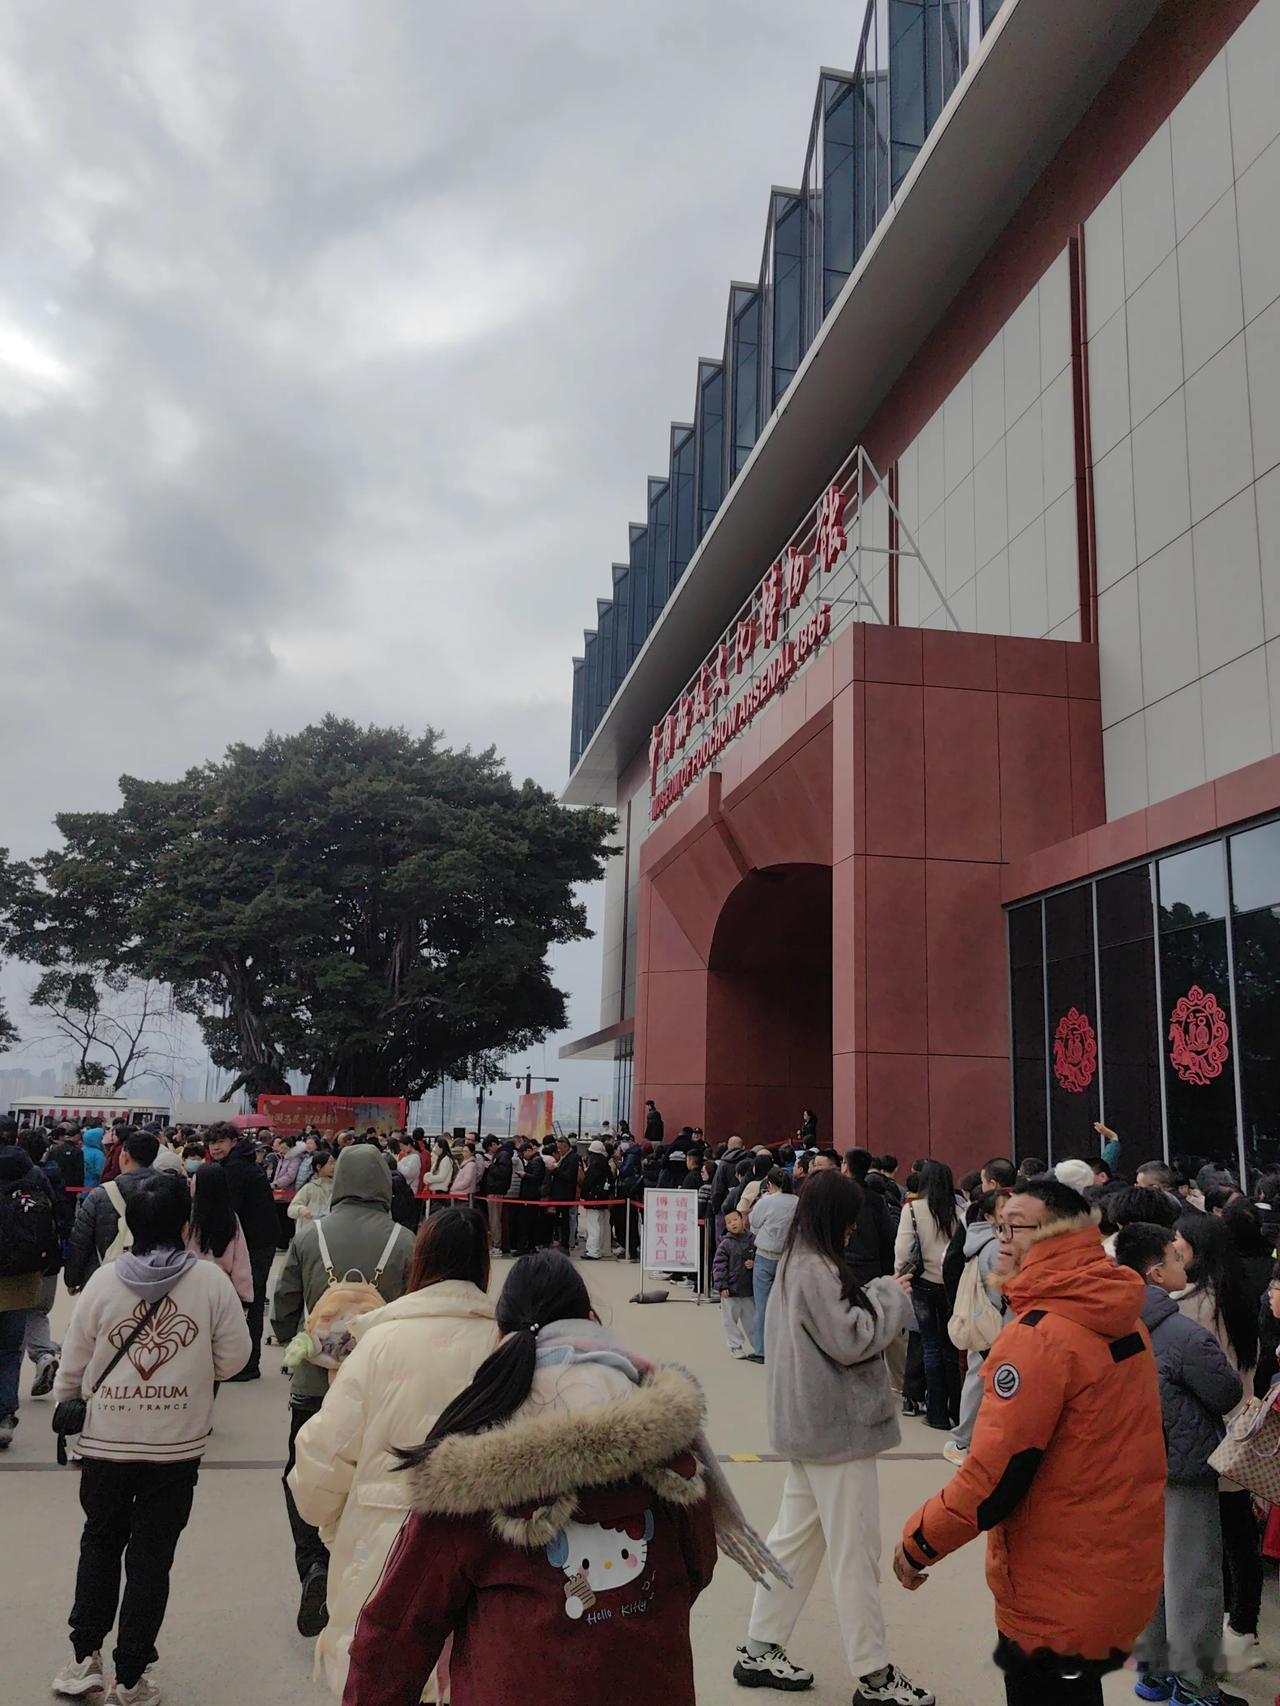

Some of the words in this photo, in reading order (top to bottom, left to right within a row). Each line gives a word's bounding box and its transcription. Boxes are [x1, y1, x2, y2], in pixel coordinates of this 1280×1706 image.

[652, 769, 684, 821] MUSEUM
[691, 703, 741, 779] FOOCHOW
[738, 640, 795, 728] ARSENAL
[794, 604, 832, 666] 1866
[656, 1196, 668, 1260] 博物馆入口
[675, 1196, 688, 1261] 请有序排队
[100, 1385, 189, 1400] PALLADIUM
[139, 1402, 188, 1411] FRANCE
[586, 1608, 612, 1625] Hello
[621, 1600, 647, 1617] Kitty
